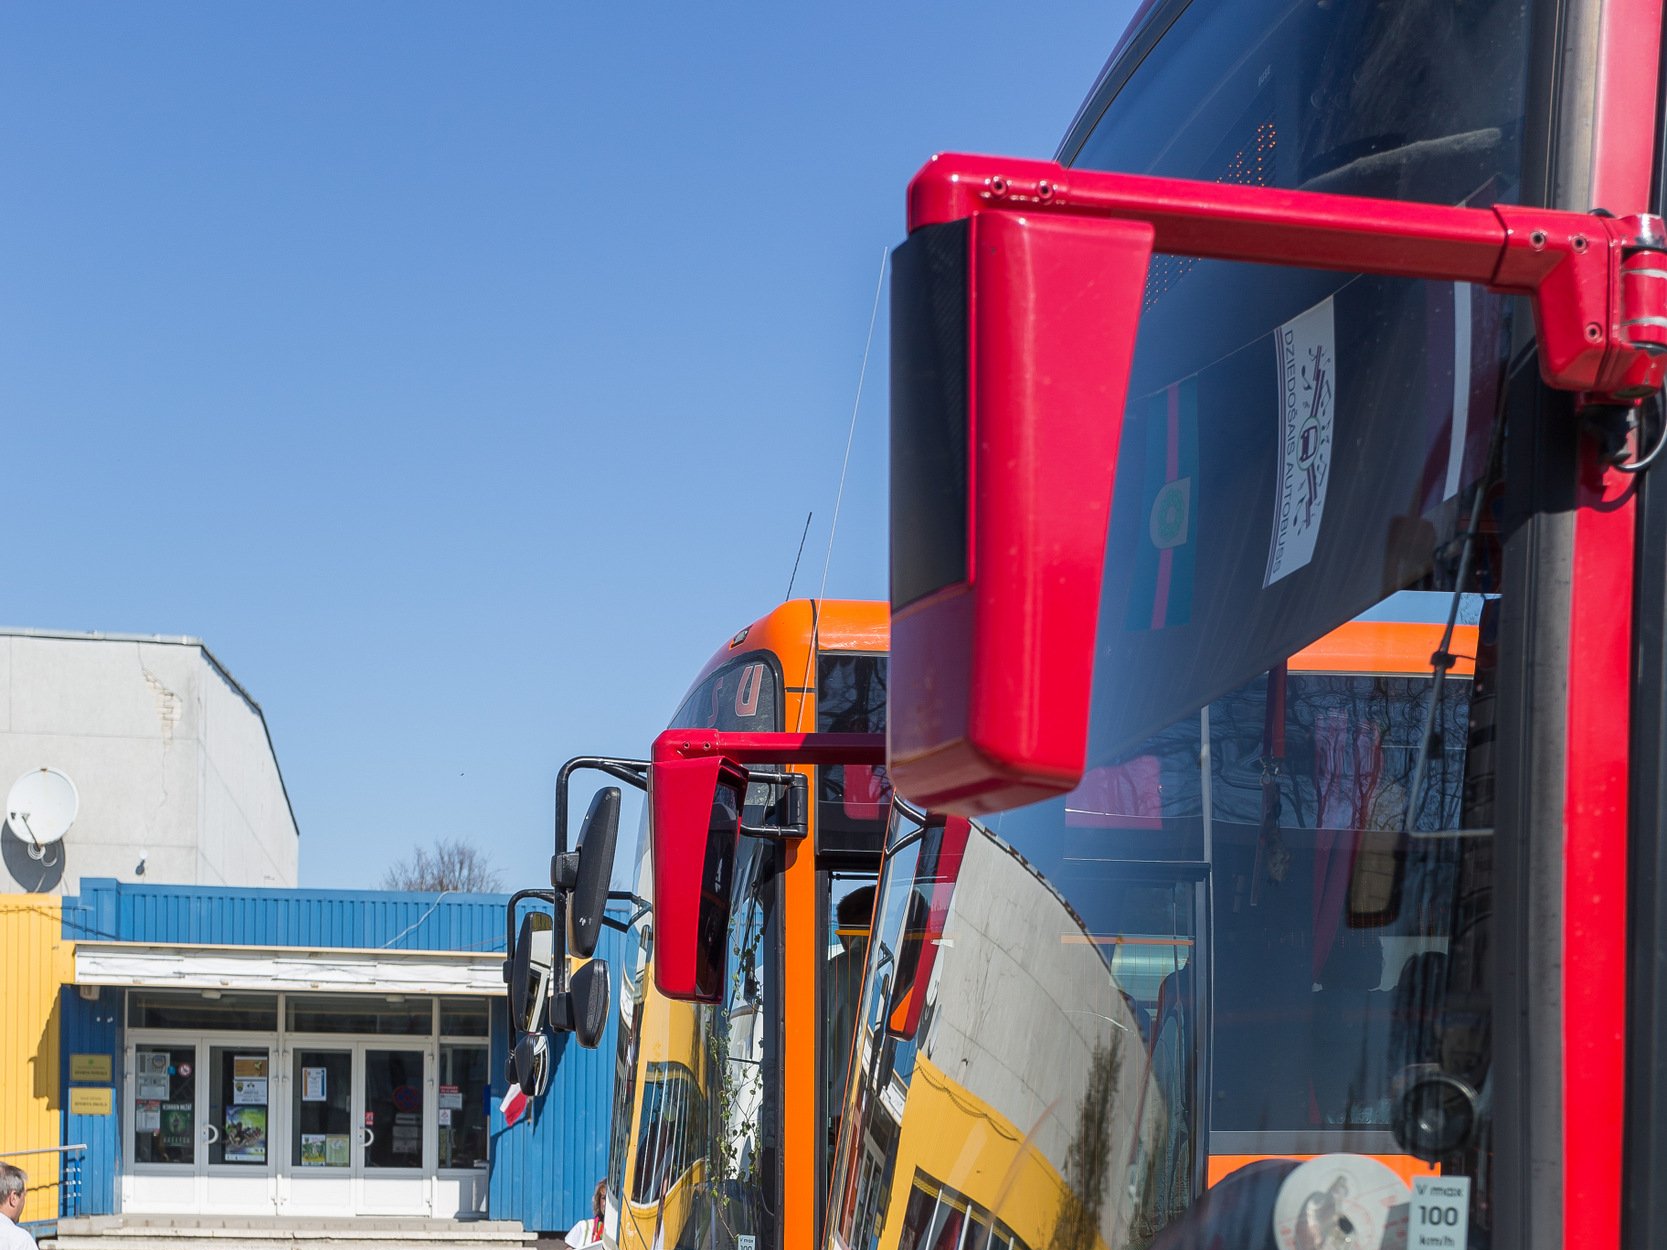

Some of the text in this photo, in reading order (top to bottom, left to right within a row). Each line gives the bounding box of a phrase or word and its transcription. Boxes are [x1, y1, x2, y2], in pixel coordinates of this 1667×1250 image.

[1273, 329, 1298, 574] DZIEDOŠAIS AUTOBUSS
[1415, 1183, 1464, 1197] V max
[1419, 1205, 1459, 1226] 100
[1419, 1234, 1455, 1248] km/h
